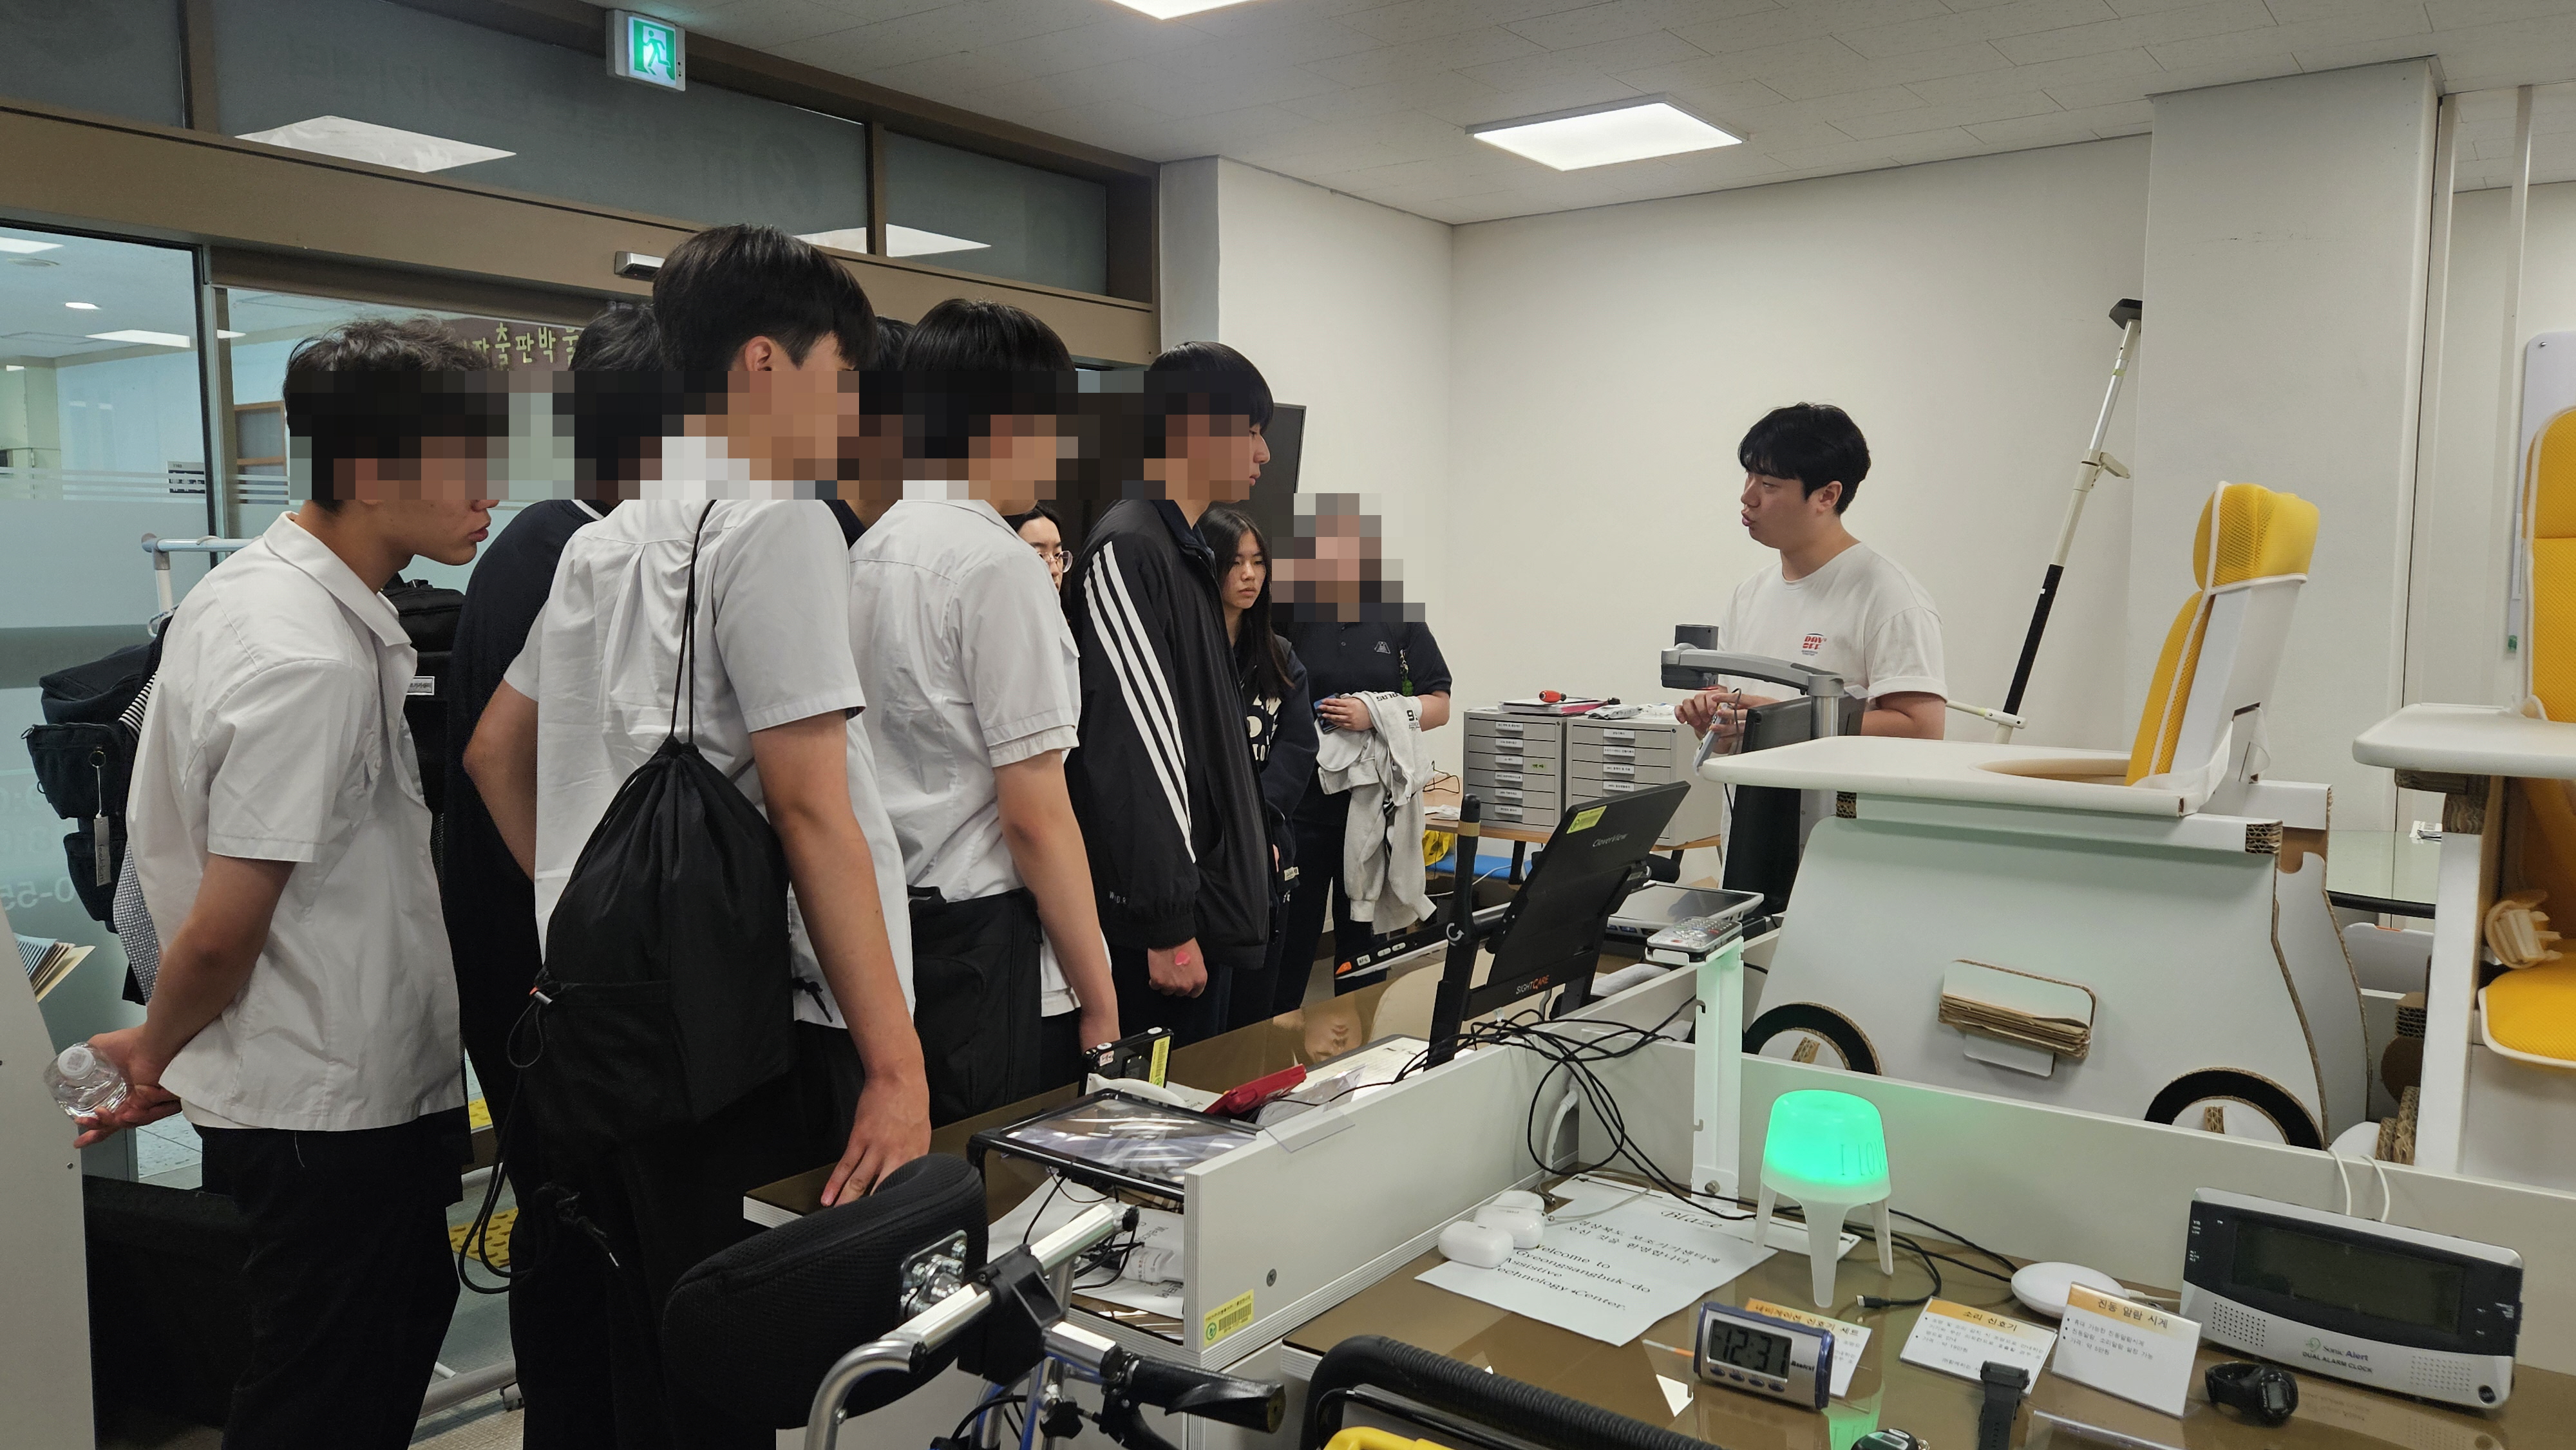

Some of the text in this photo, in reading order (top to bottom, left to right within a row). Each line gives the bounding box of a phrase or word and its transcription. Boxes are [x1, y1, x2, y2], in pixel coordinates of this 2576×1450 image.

[1497, 1265, 1569, 1292] echnology
[1963, 1311, 2017, 1332] 소리 신호기
[2098, 1298, 2168, 1329] 진동 알람 시계
[1840, 1326, 1859, 1336] 세트
[2302, 1351, 2372, 1373] DUAL ALARM CLOCK
[2345, 1351, 2369, 1361] Alert
